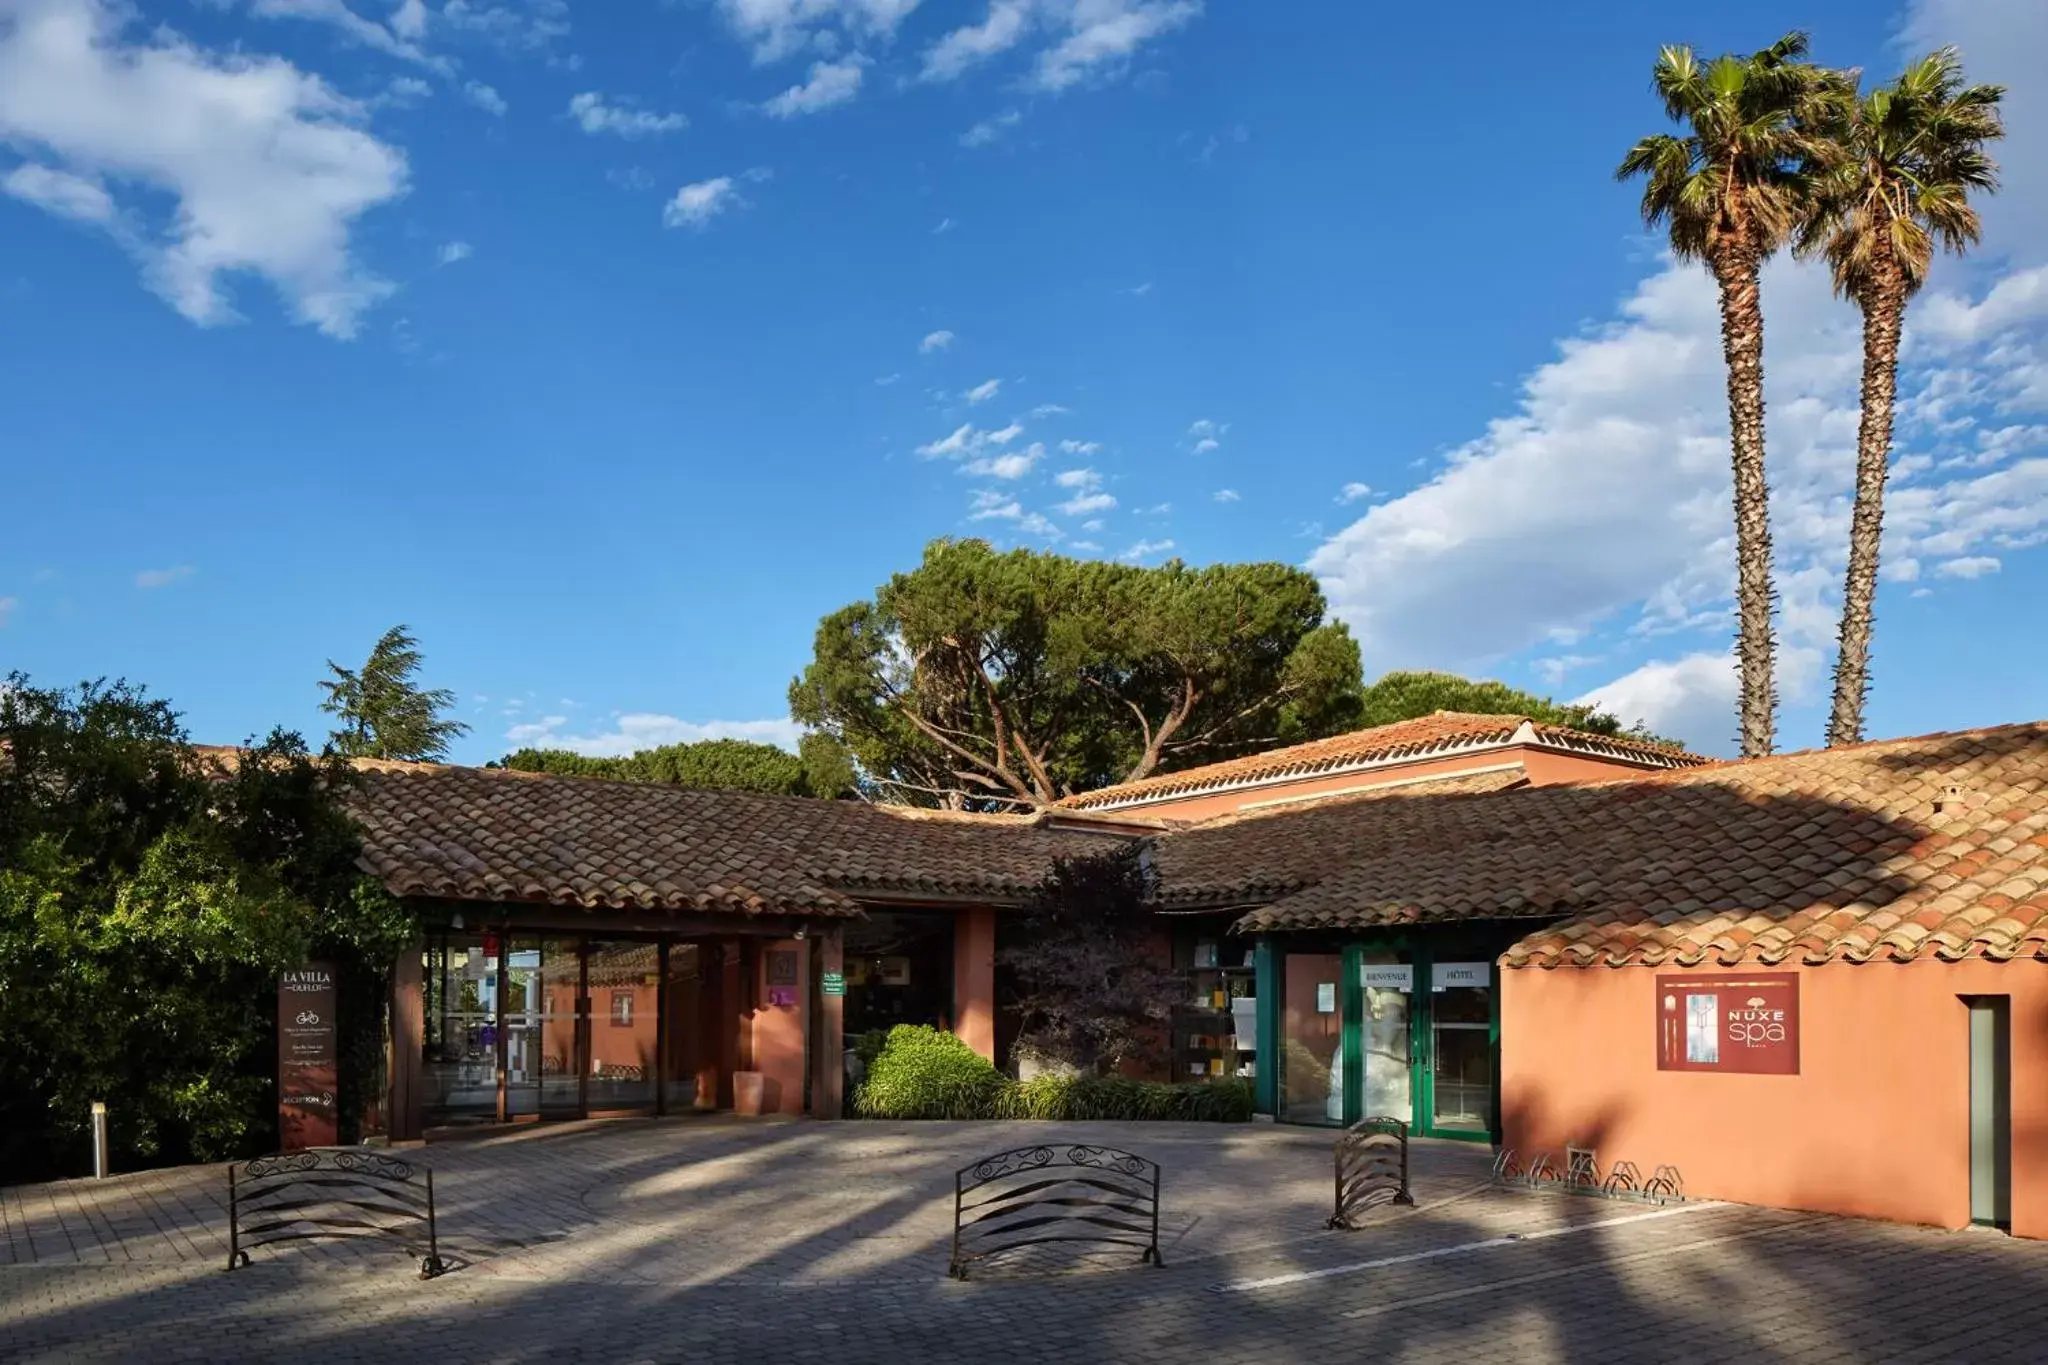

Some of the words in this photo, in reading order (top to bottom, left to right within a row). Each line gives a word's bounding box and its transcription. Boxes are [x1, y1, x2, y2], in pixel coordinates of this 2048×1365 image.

[283, 971, 297, 982] LA
[300, 971, 330, 982] VILLA
[1366, 972, 1408, 981] BIENVENUE
[1729, 1011, 1784, 1021] NUXE
[1729, 1023, 1785, 1048] spa
